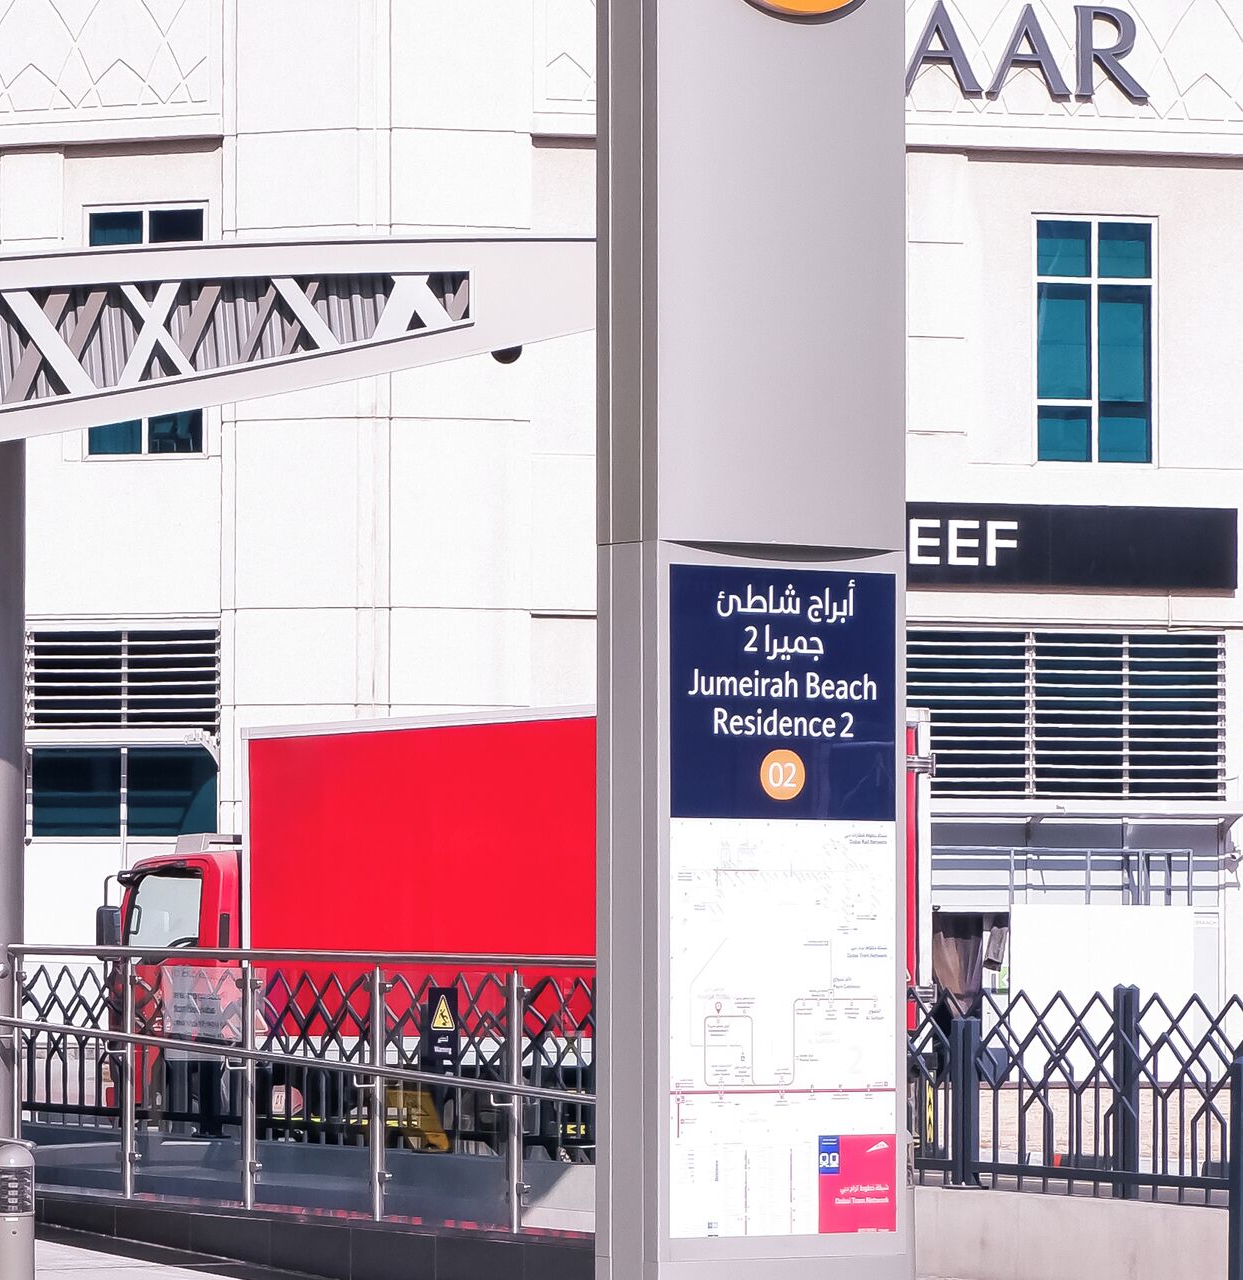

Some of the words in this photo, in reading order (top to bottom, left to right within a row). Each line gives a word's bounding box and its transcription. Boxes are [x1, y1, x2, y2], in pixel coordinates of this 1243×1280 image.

[909, 518, 1018, 566] EEF
[716, 583, 801, 617] شاطئ
[807, 580, 856, 624] أبراج
[743, 625, 758, 652] 2
[765, 624, 824, 661] جميرا
[688, 668, 798, 698] Jumeirah
[806, 671, 877, 700] Beach
[713, 707, 836, 737] Residence
[840, 711, 854, 738] 2
[768, 761, 797, 788] 02
